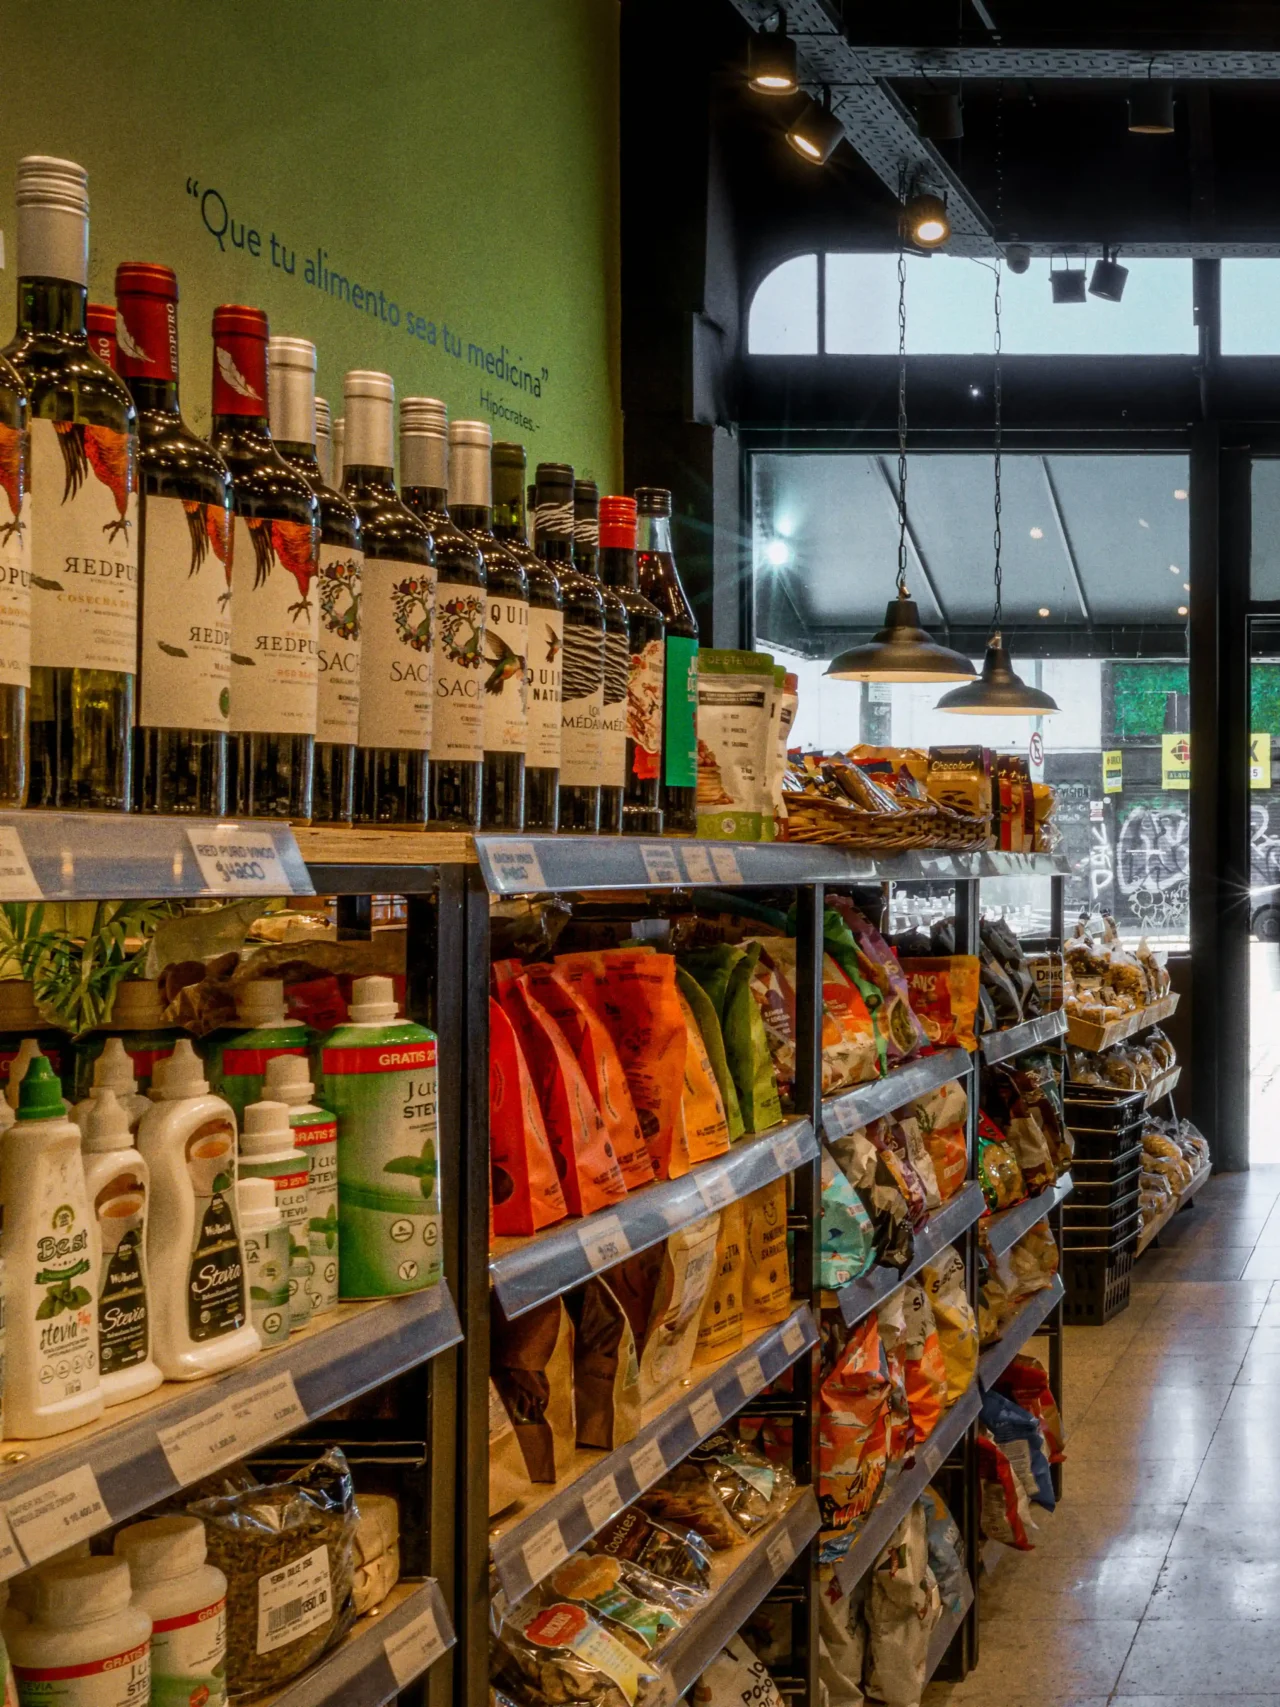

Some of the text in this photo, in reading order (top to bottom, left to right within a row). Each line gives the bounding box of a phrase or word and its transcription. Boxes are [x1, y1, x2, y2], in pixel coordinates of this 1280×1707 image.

[270, 232, 295, 275] tu
[304, 248, 400, 327] alimento
[406, 311, 437, 346] sea
[442, 324, 462, 358] tu
[931, 760, 975, 771] Chocolart
[378, 1051, 425, 1066] GRATIS
[280, 1207, 308, 1219] TEVIA
[37, 1229, 88, 1263] Best
[191, 1263, 241, 1293] Stevia
[99, 1307, 146, 1333] Stevia
[604, 1513, 638, 1554] Cookies
